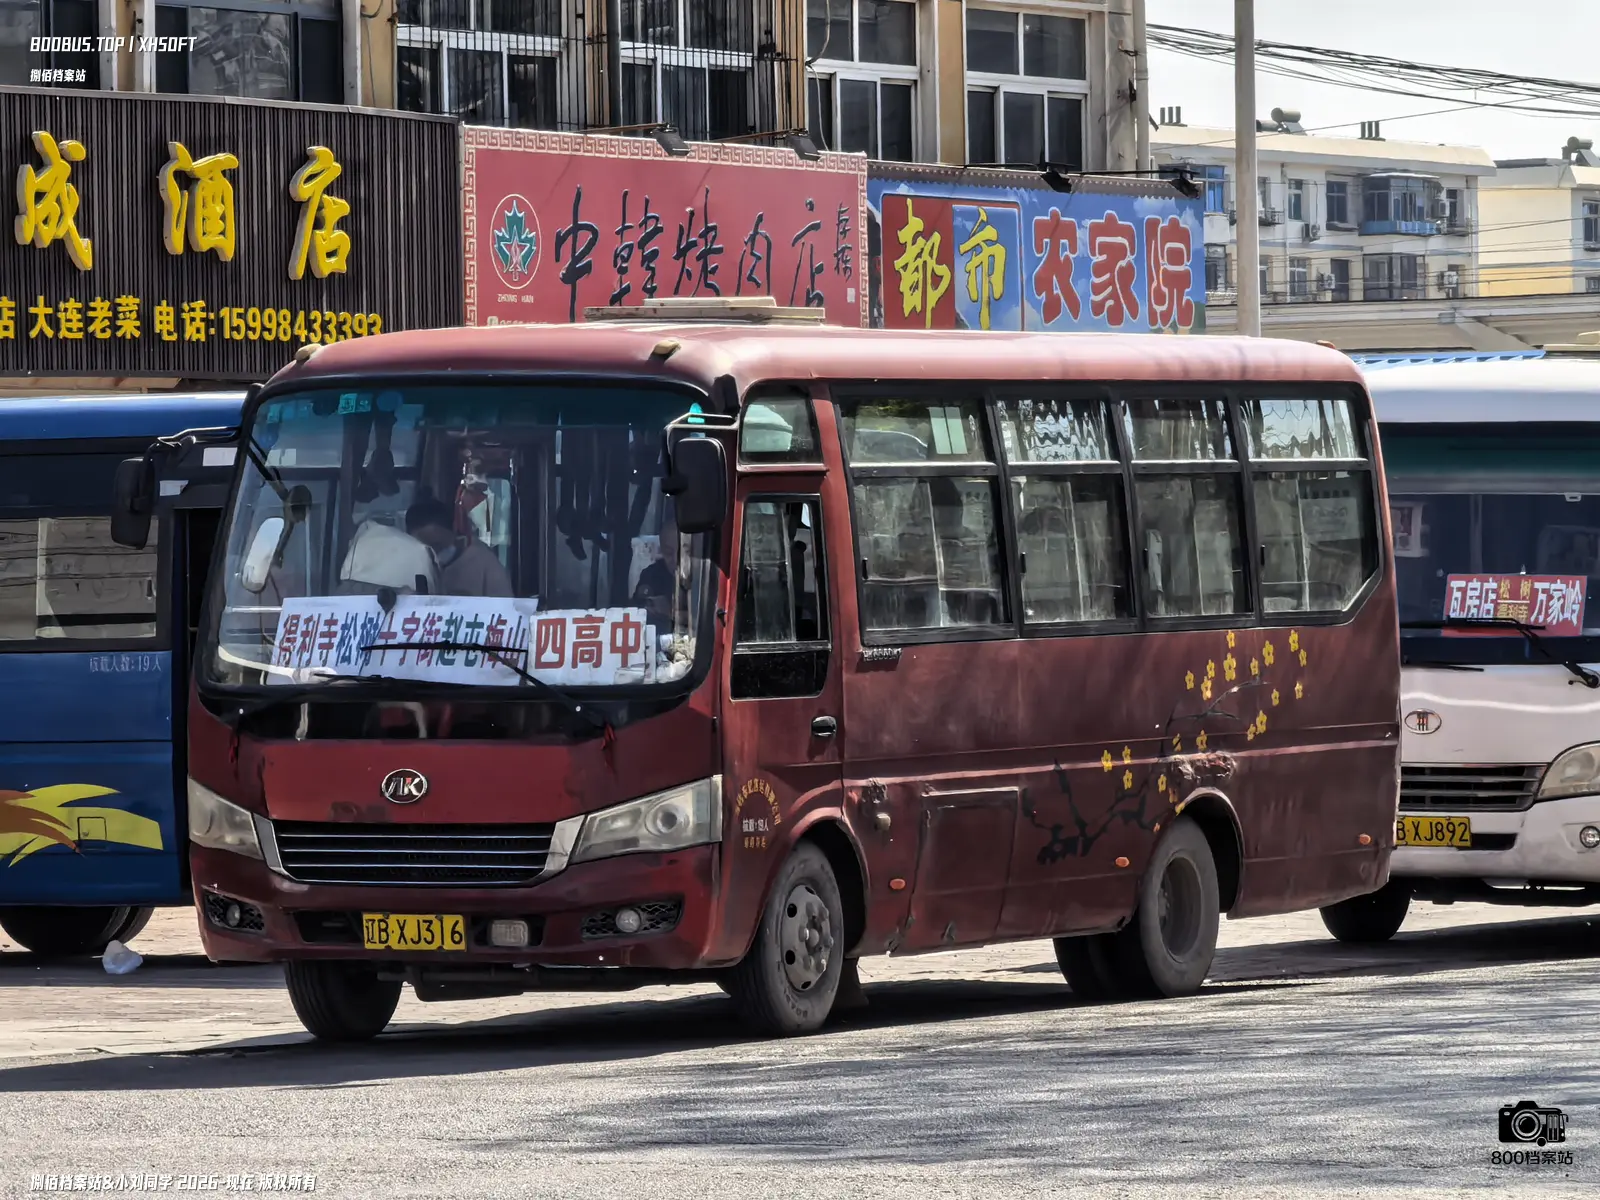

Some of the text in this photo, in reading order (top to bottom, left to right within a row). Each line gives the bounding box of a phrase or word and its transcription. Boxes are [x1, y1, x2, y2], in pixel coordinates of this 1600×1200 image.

[894, 198, 1007, 330] 都市
[1032, 207, 1195, 329] 农家院
[28, 295, 141, 340] 大连老菜
[1449, 577, 1583, 627] 瓦房店 万家岭
[535, 612, 641, 669] 四高中
